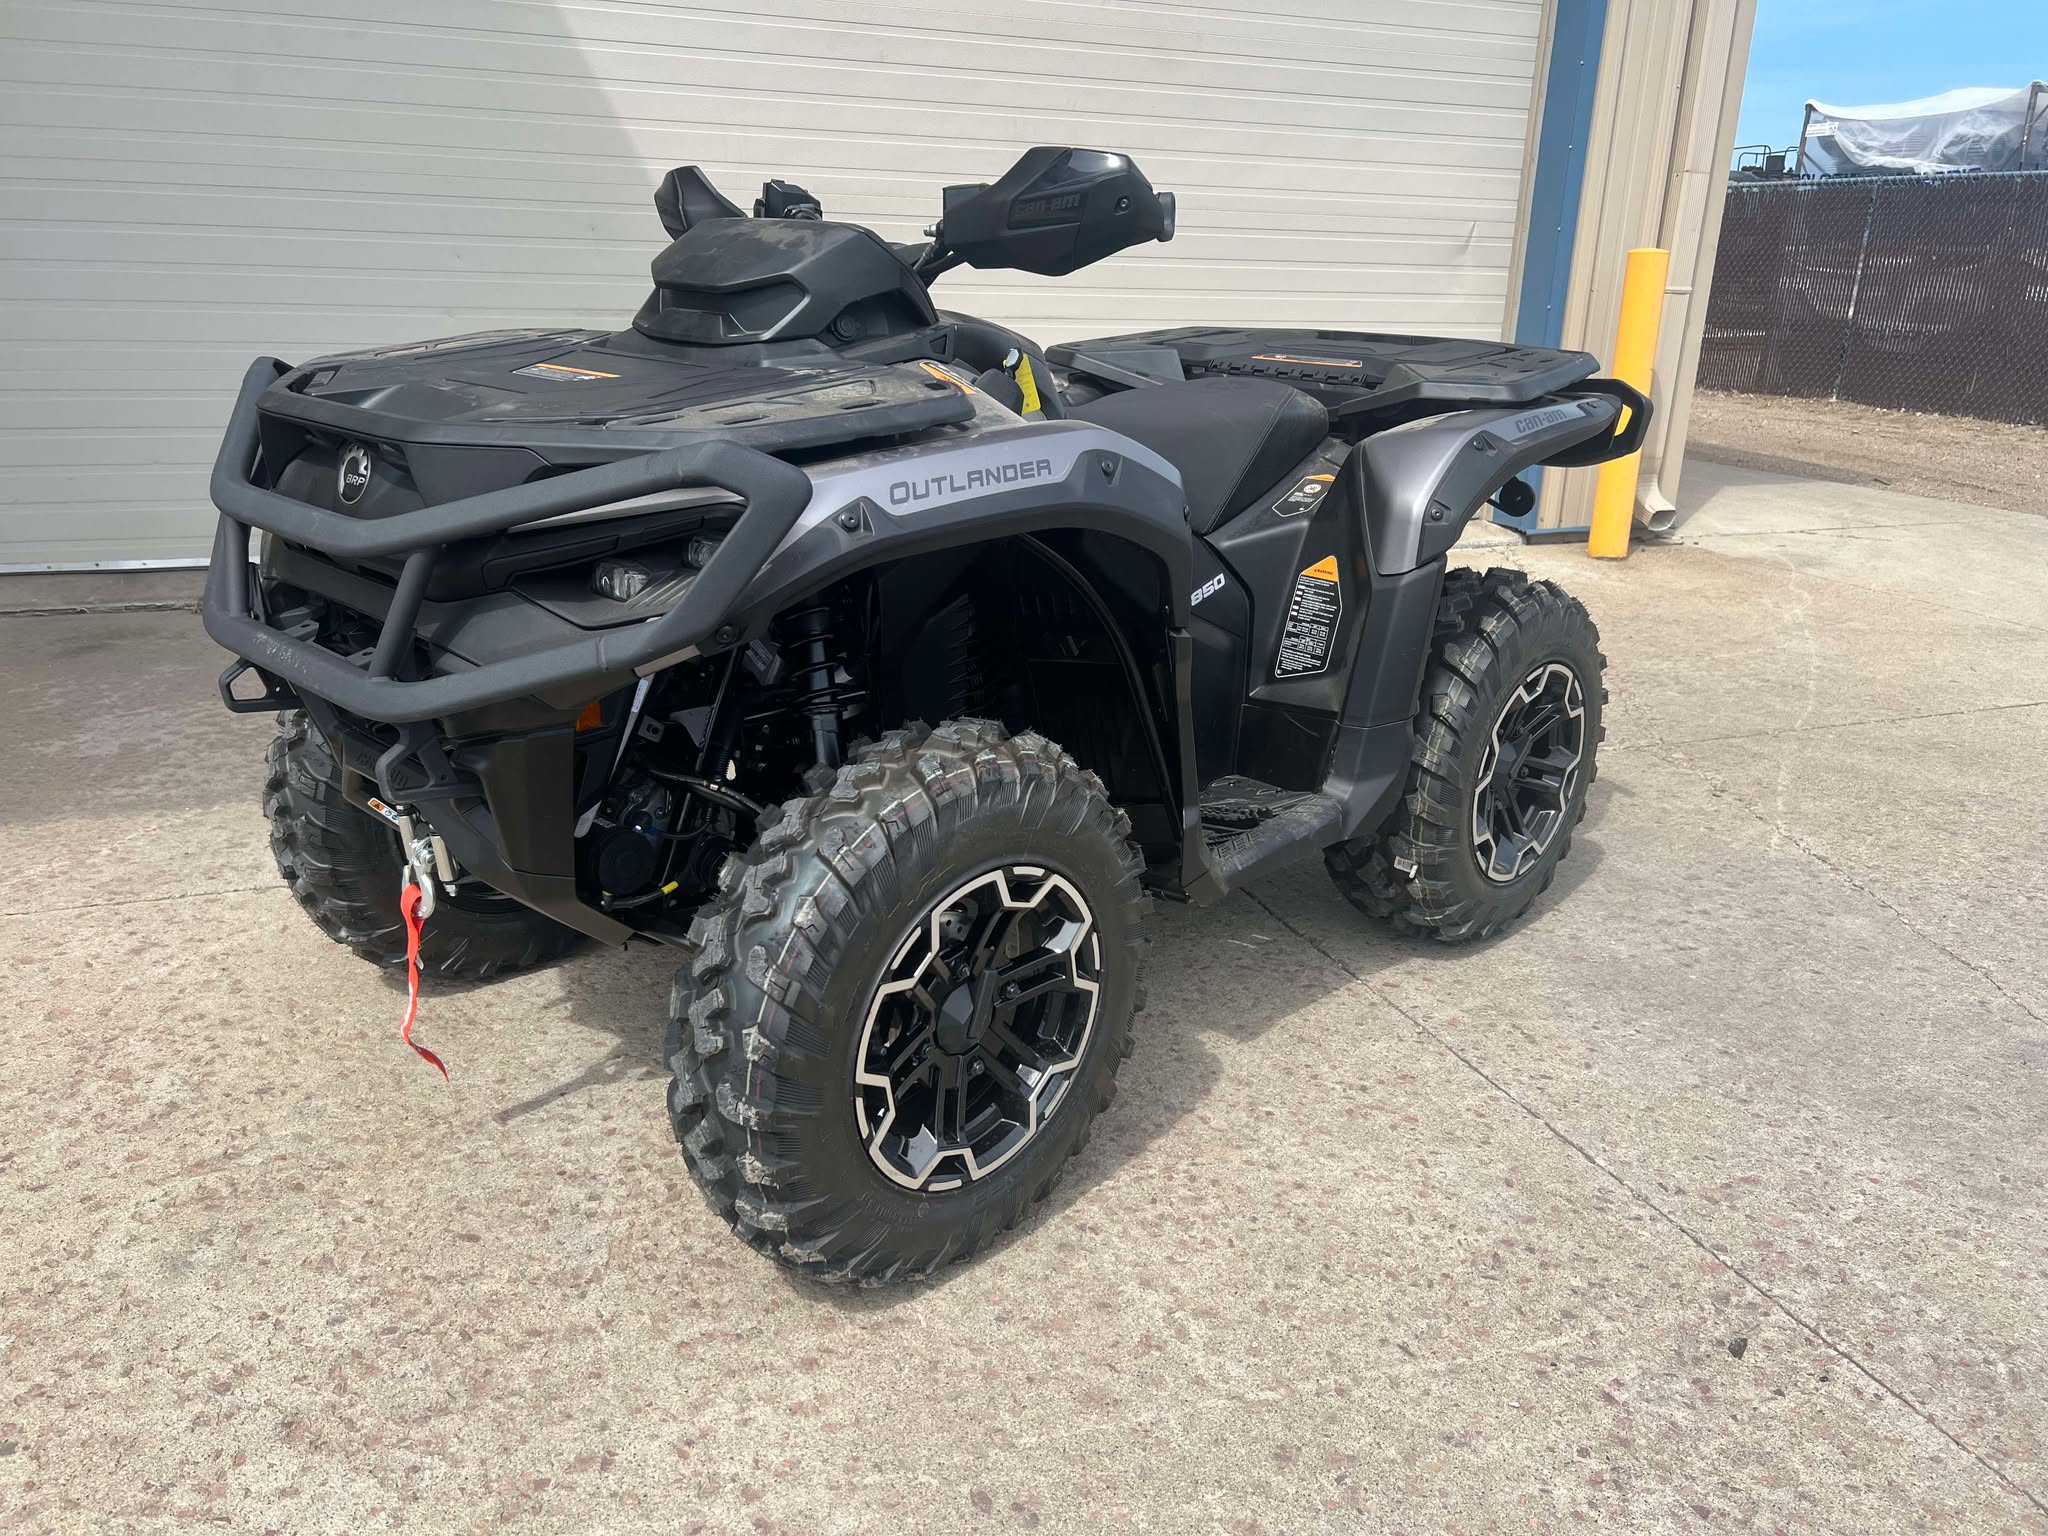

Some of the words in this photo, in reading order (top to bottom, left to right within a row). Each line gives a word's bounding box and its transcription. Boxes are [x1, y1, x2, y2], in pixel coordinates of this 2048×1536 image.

[1015, 193, 1081, 216] can-am
[1514, 409, 1568, 434] can-am
[346, 473, 366, 486] BRP
[889, 459, 1052, 506] OUTLANDER
[1190, 572, 1226, 606] 850
